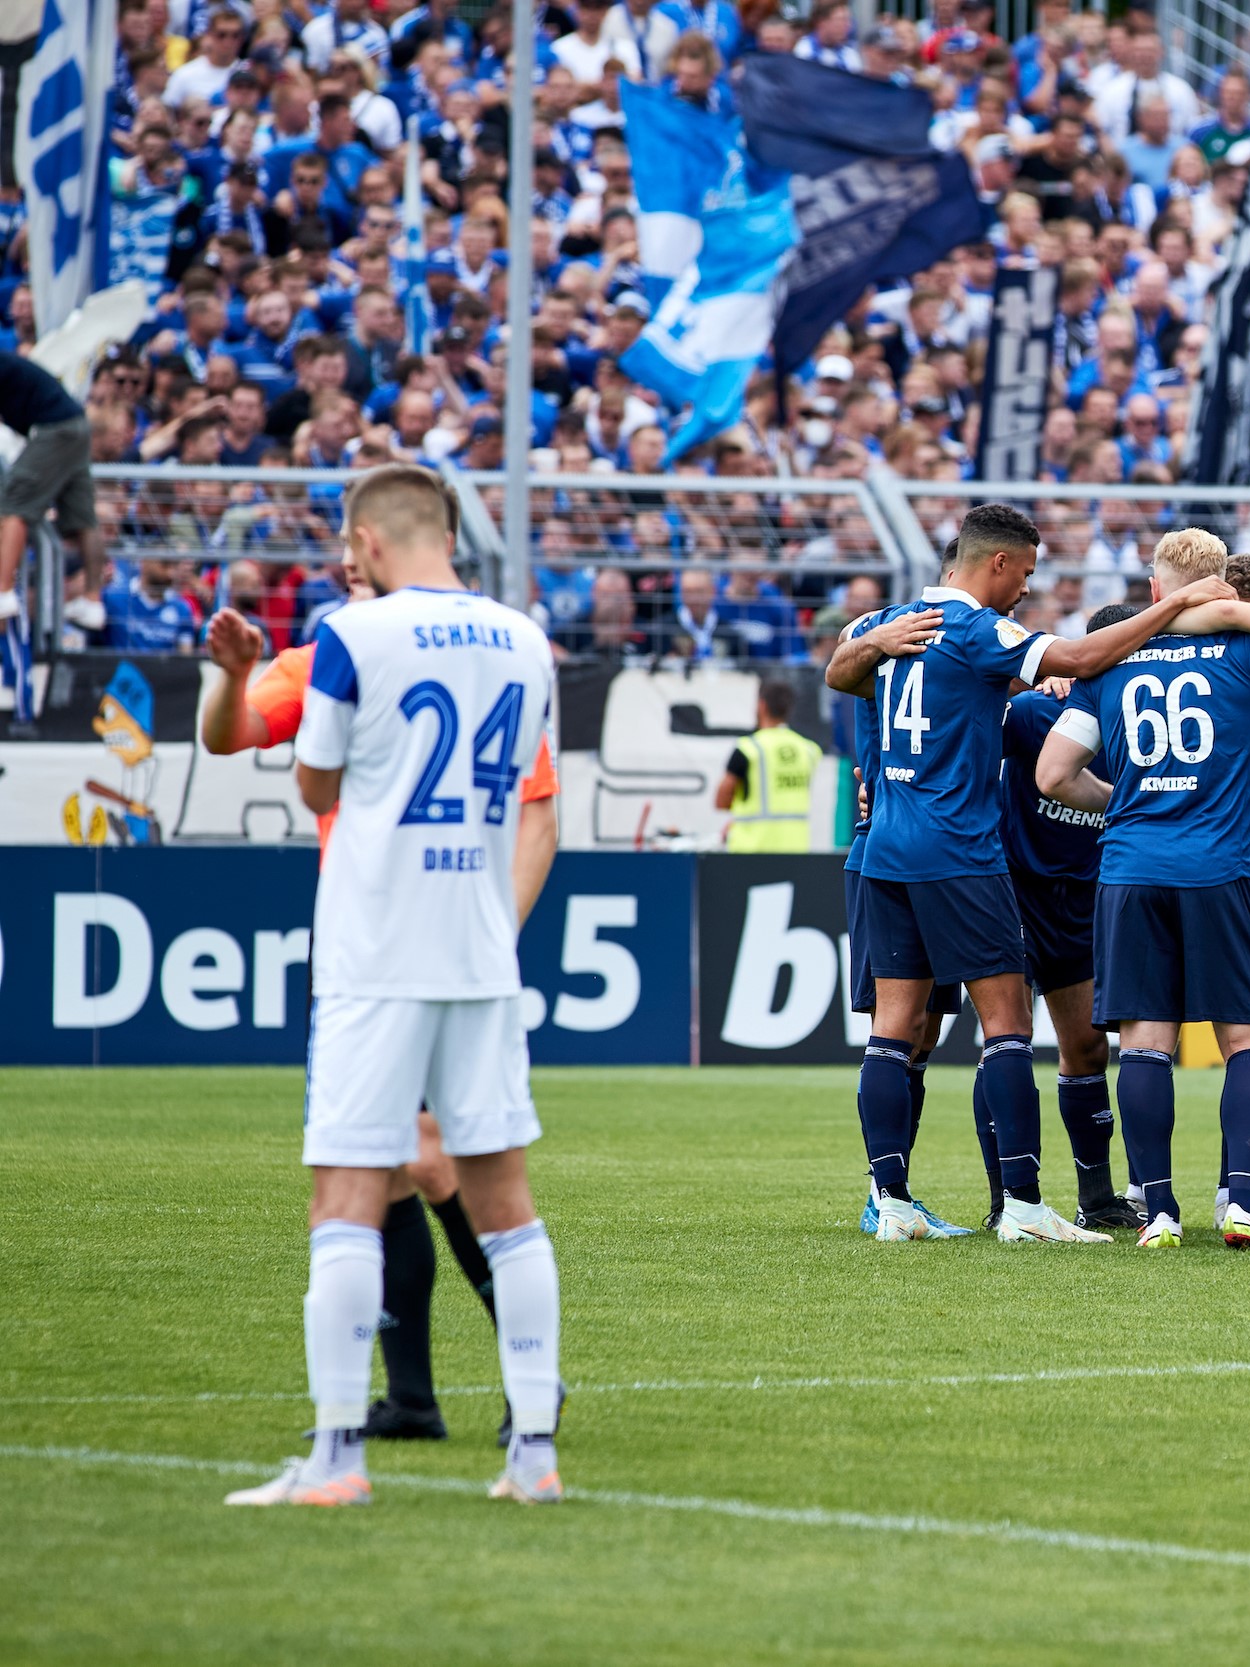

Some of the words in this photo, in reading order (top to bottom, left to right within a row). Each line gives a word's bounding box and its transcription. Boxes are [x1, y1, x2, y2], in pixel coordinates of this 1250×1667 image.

[1117, 645, 1196, 665] REMER
[1200, 645, 1226, 659] SV
[398, 680, 525, 826] 24
[877, 658, 931, 754] 14
[1122, 671, 1215, 767] 66
[1036, 797, 1108, 830] TÜRENH
[1139, 776, 1198, 792] KMIEC
[53, 893, 310, 1031] Der
